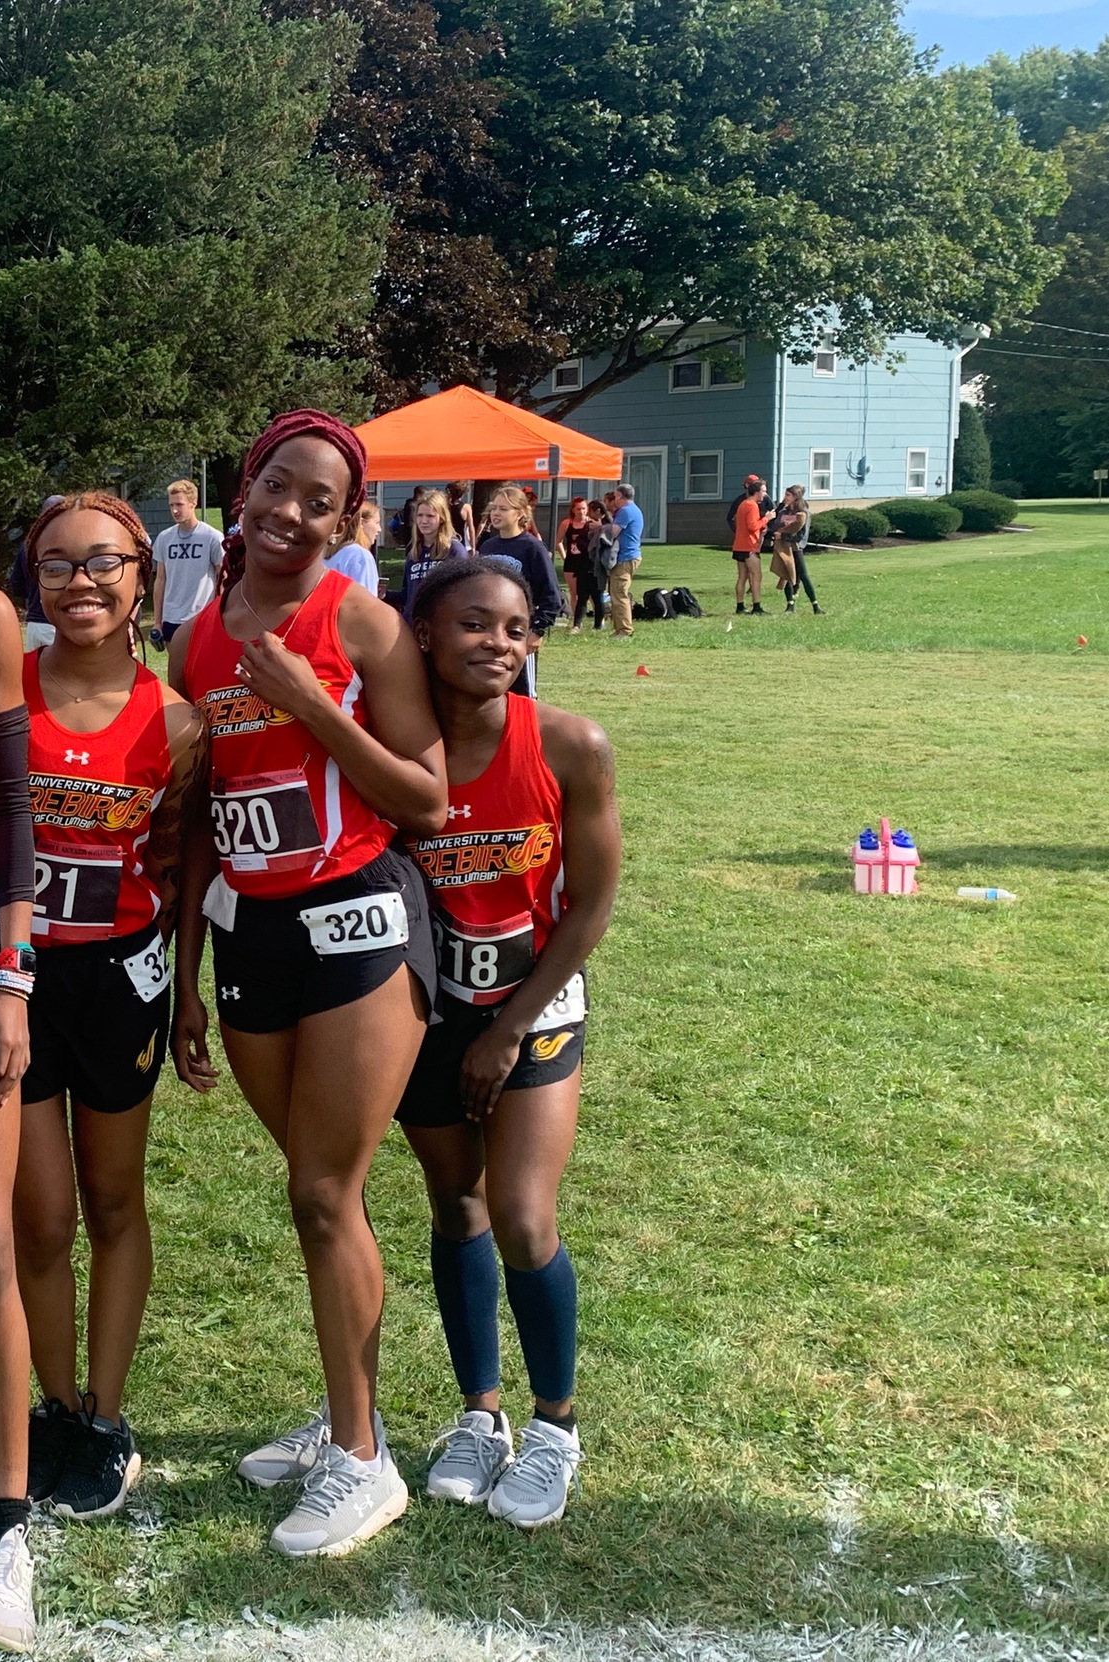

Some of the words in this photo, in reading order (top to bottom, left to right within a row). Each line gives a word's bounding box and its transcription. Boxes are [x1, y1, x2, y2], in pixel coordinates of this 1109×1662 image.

[168, 543, 203, 560] GXC
[206, 687, 253, 703] UNIVERSI
[217, 720, 266, 735] COLUMBIA
[28, 776, 101, 794] UNIVERSITY
[102, 785, 115, 796] OF
[117, 788, 134, 799] THE
[28, 787, 155, 829] REBIRDS
[34, 814, 46, 823] OF
[46, 813, 96, 829] COLUMBIA
[211, 797, 280, 855] 320
[414, 823, 554, 877] REBIRDS
[418, 834, 489, 851] UNIVERSITY
[492, 834, 505, 843] OF
[507, 831, 527, 842] THE
[33, 861, 79, 919] 21
[433, 877, 444, 887] OF
[444, 871, 498, 885] COLUMBIA
[325, 905, 388, 942] 320
[144, 942, 170, 983] 32
